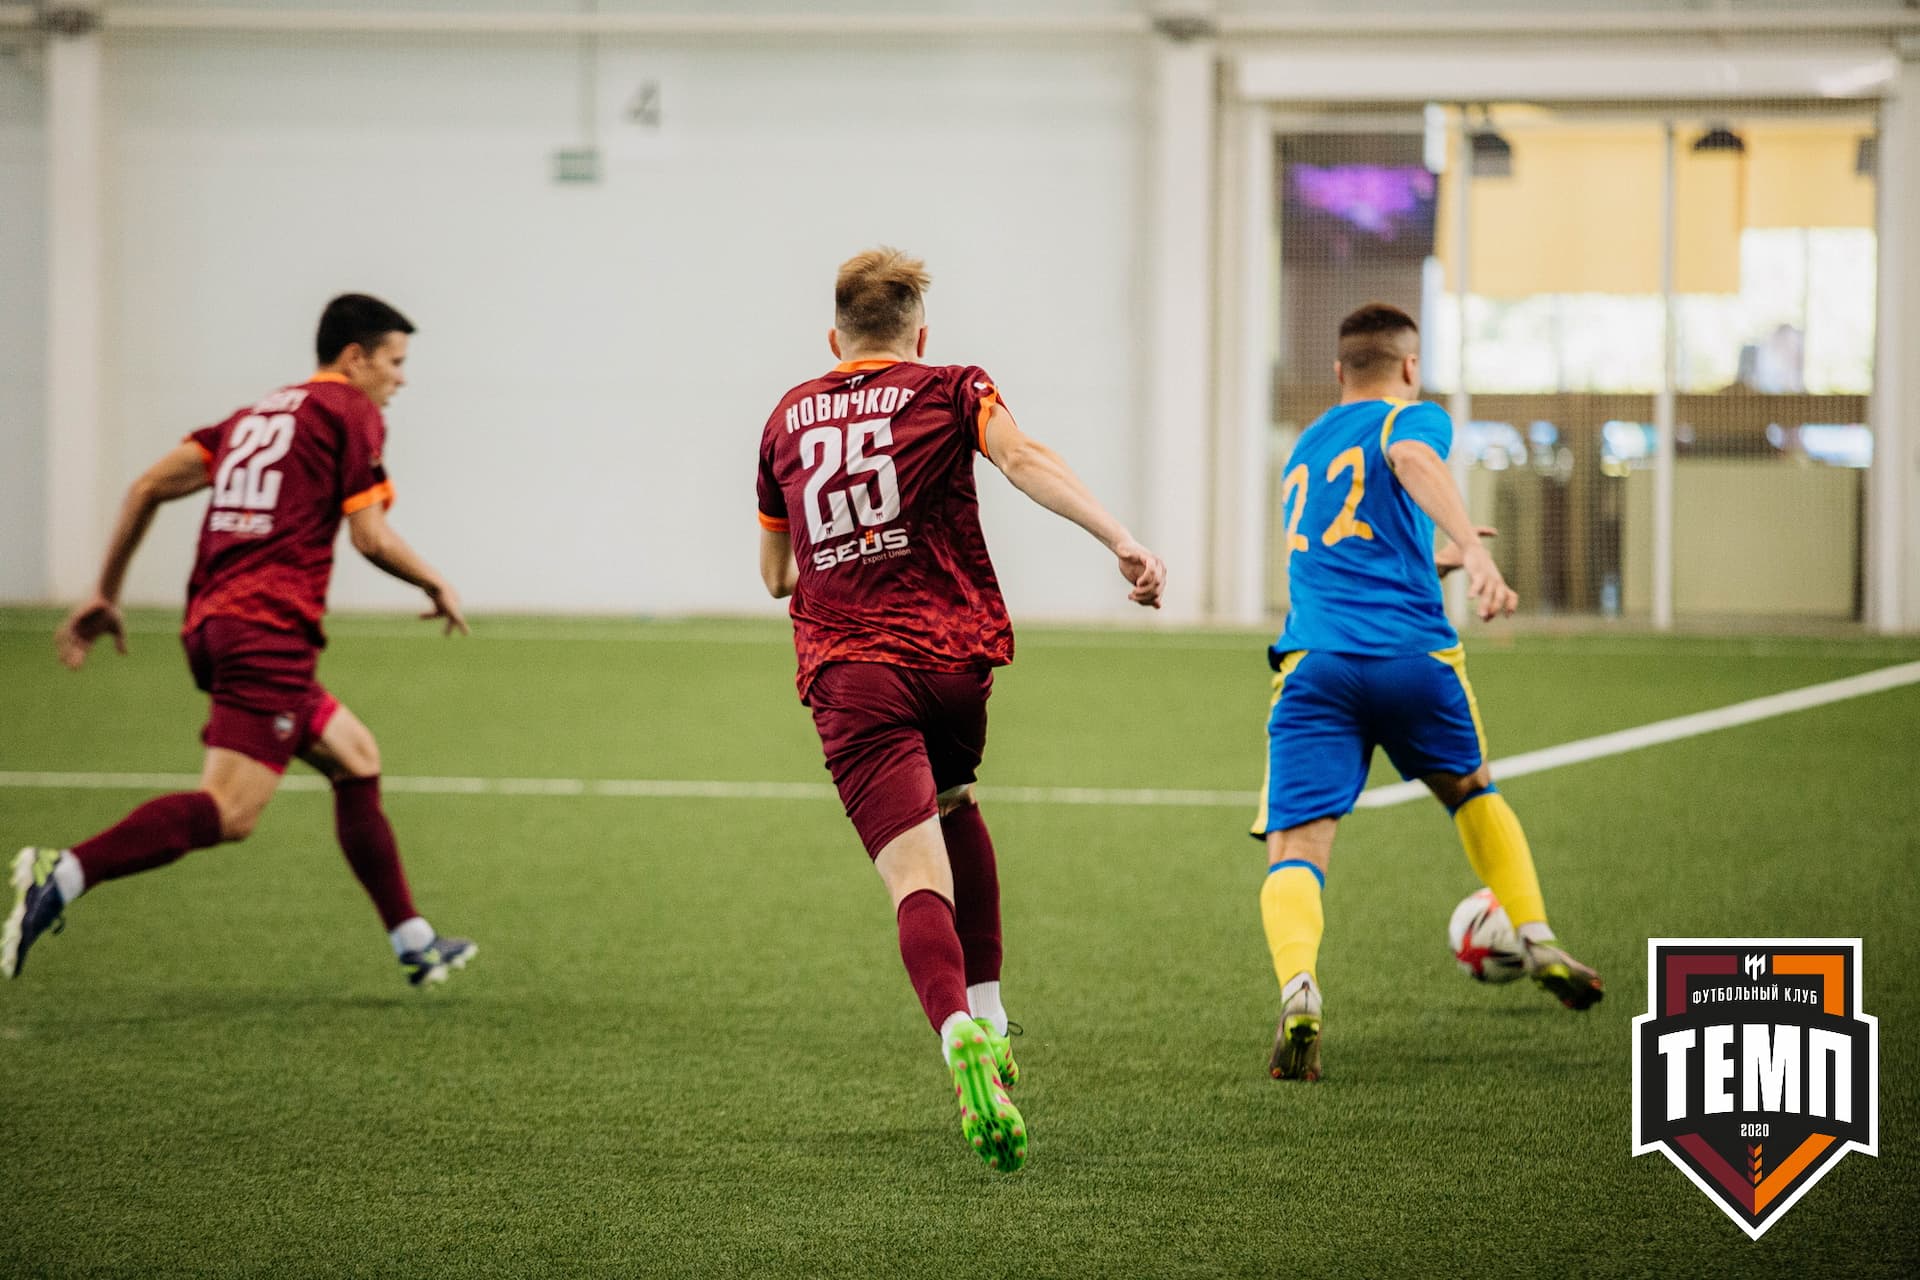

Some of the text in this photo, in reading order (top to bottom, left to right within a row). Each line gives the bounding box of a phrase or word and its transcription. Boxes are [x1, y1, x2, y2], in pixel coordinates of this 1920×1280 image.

[213, 413, 296, 511] 22
[800, 416, 901, 546] 25
[1282, 445, 1374, 553] 22
[812, 528, 909, 571] SEUS
[862, 548, 912, 565] Export Union
